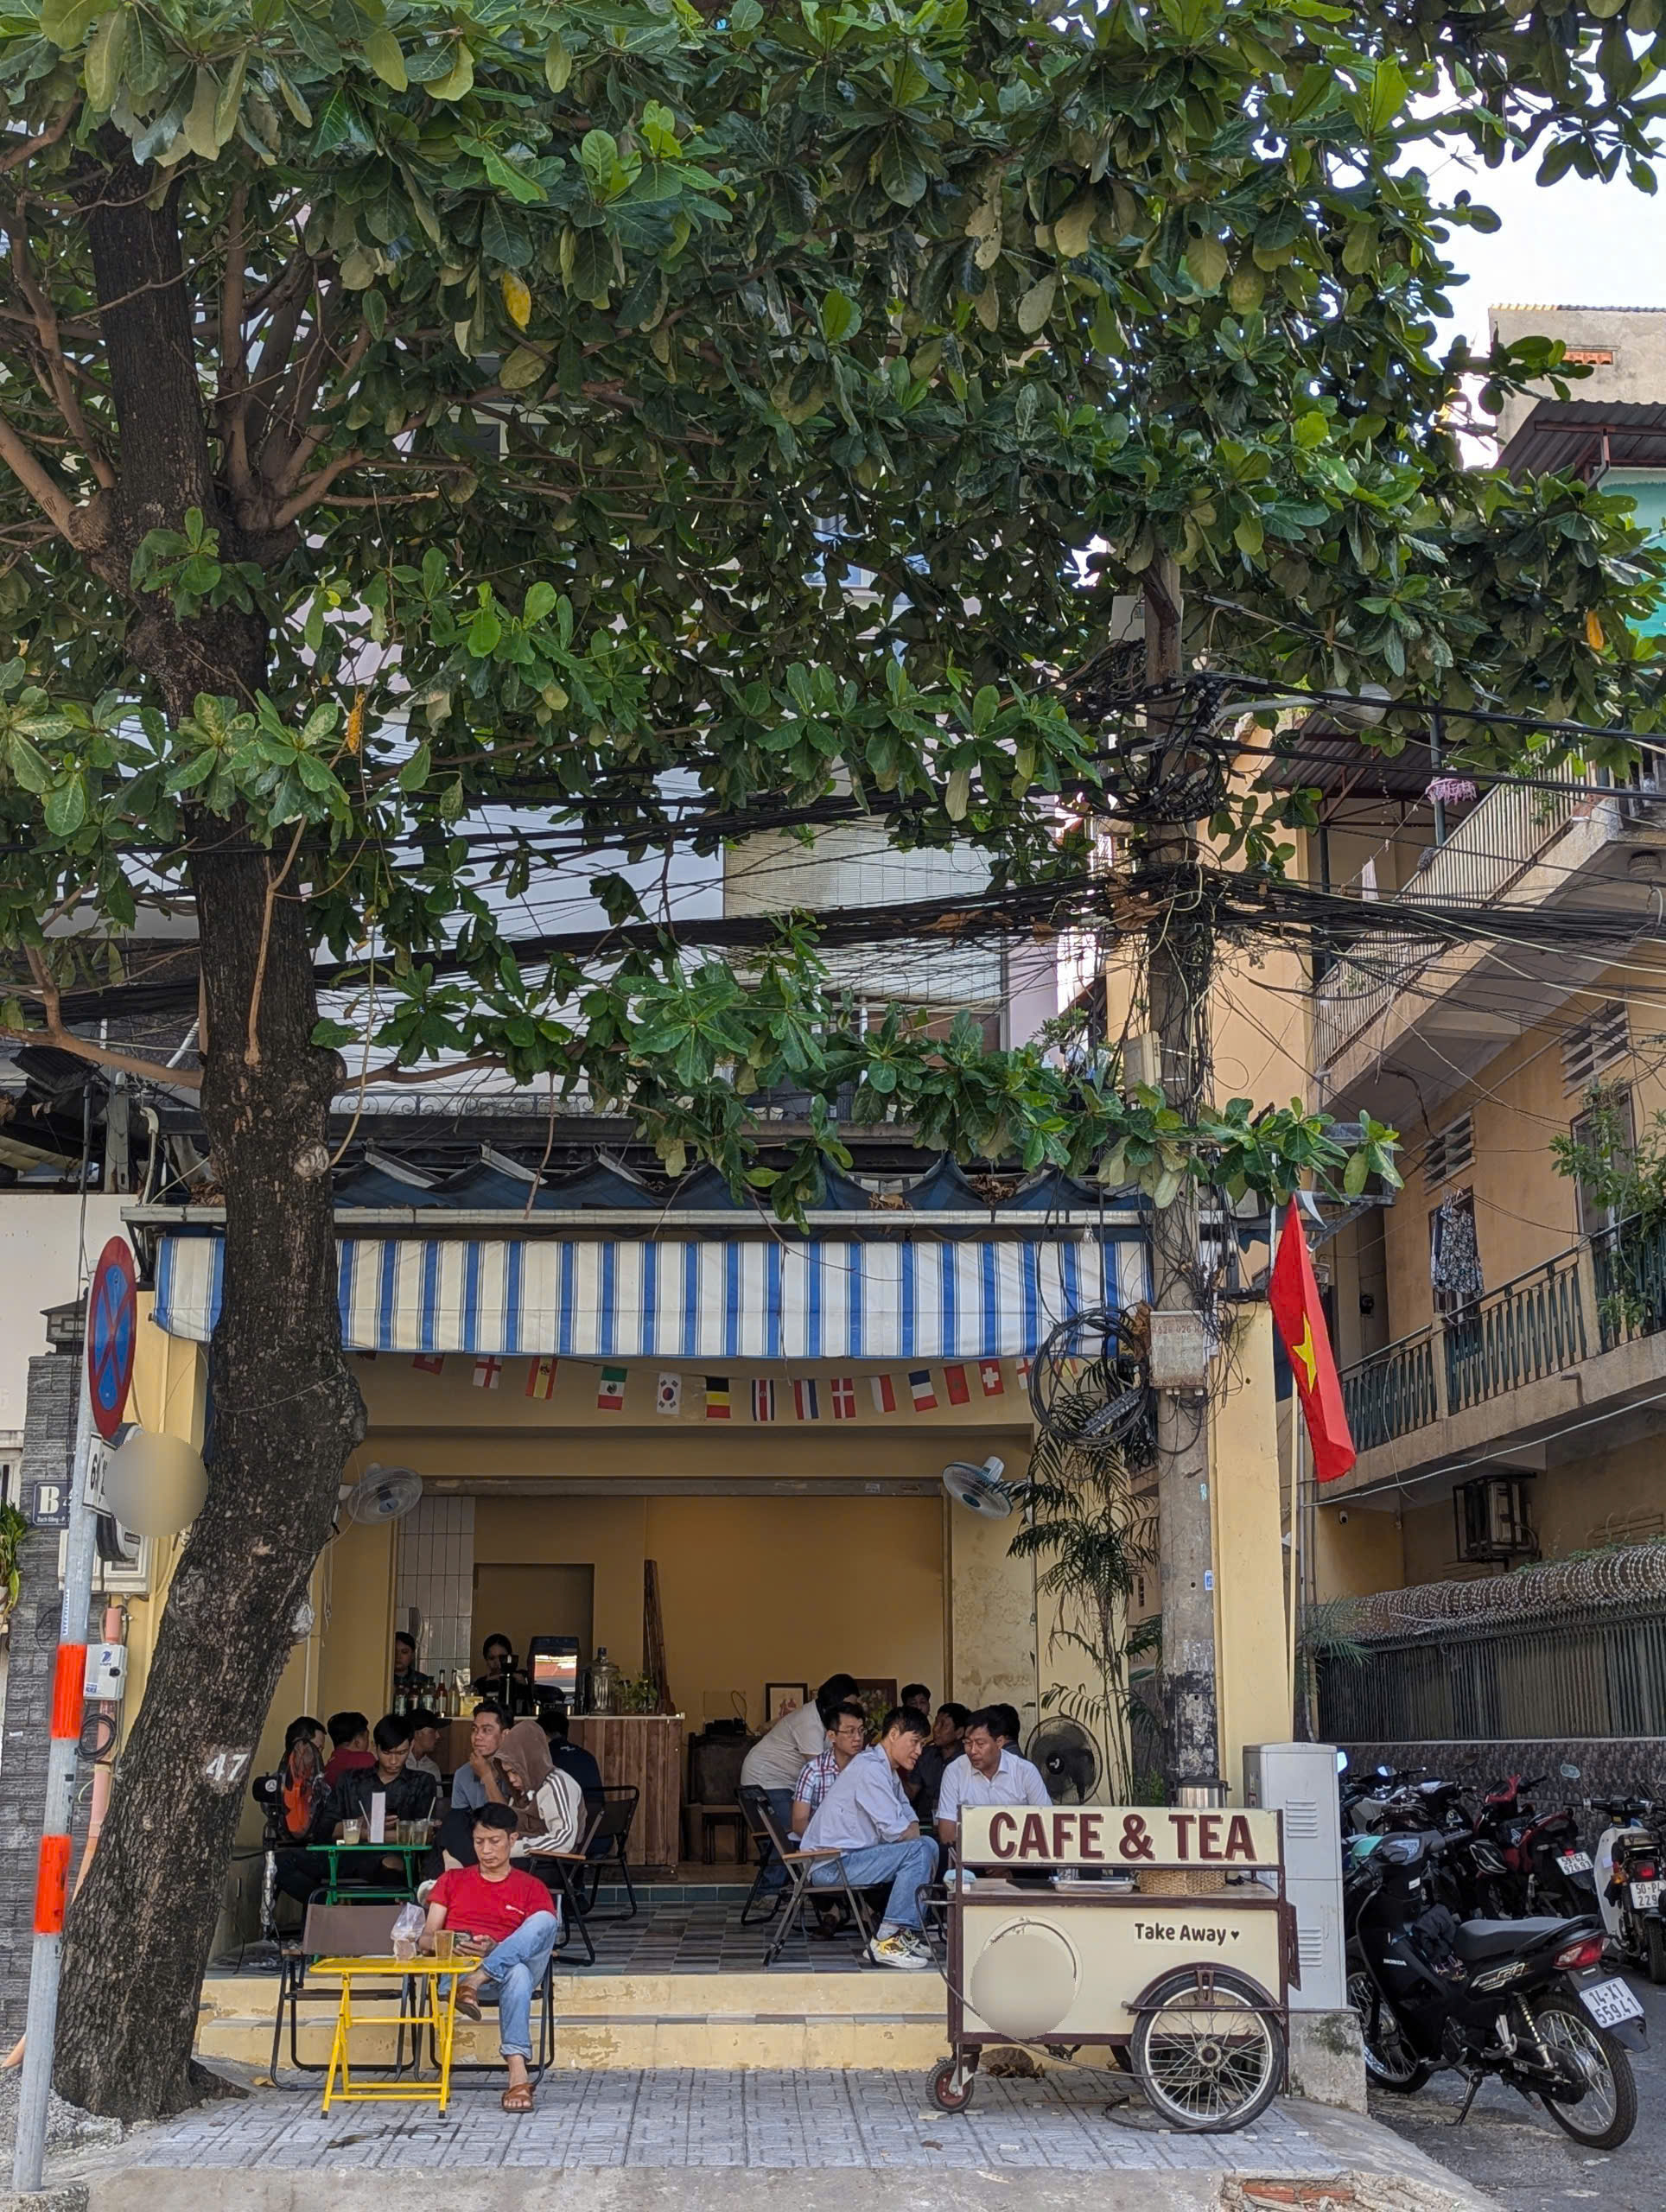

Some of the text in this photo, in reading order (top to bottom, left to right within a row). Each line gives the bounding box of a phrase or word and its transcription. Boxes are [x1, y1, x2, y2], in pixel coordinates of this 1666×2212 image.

[207, 1753, 249, 1781] 47
[989, 1811, 1258, 1862] CAFE & TEA
[1134, 1923, 1227, 1946] Take Away
[1594, 1997, 1639, 2024] 559.41
